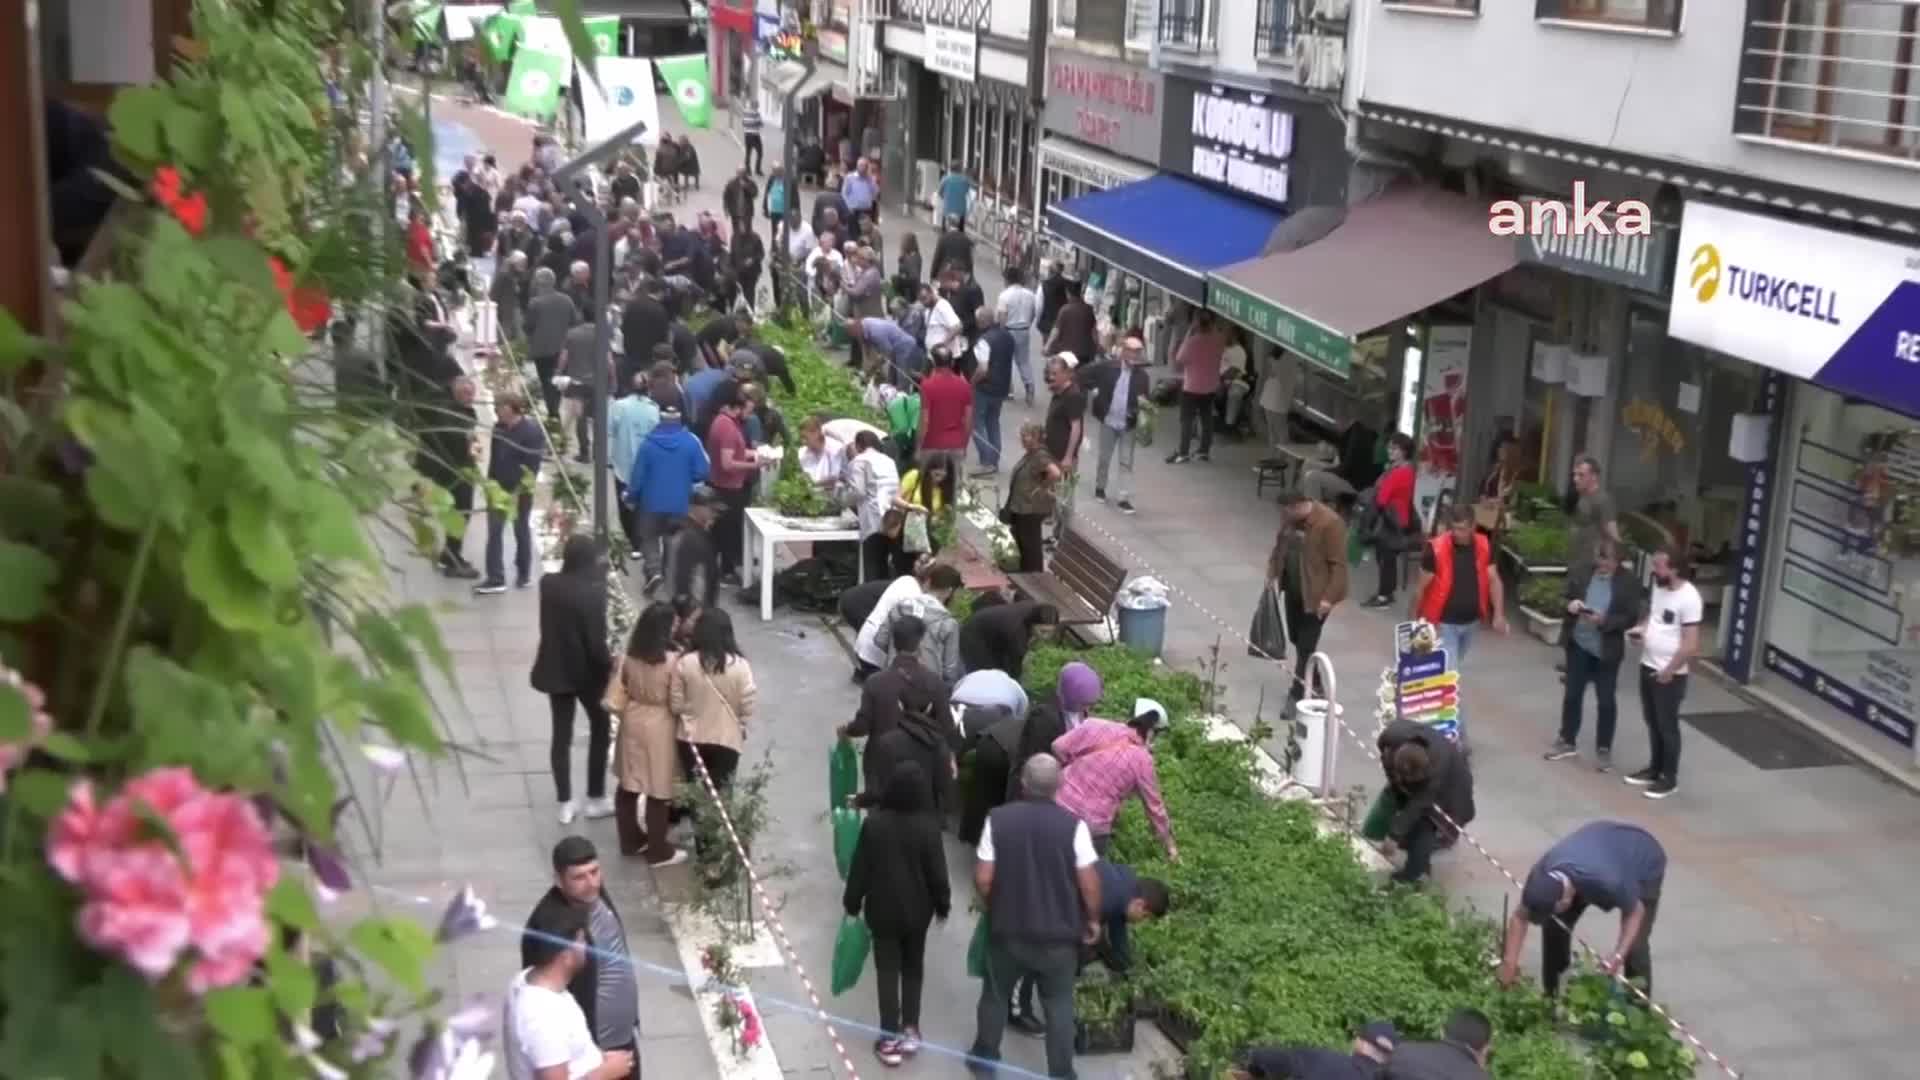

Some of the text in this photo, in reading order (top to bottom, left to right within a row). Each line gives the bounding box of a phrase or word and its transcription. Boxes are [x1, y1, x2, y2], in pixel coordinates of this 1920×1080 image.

[1192, 84, 1294, 159] KÖROĞLU
[1727, 264, 1841, 326] TURKCELL
[1732, 555, 1755, 662] NOKTASI
